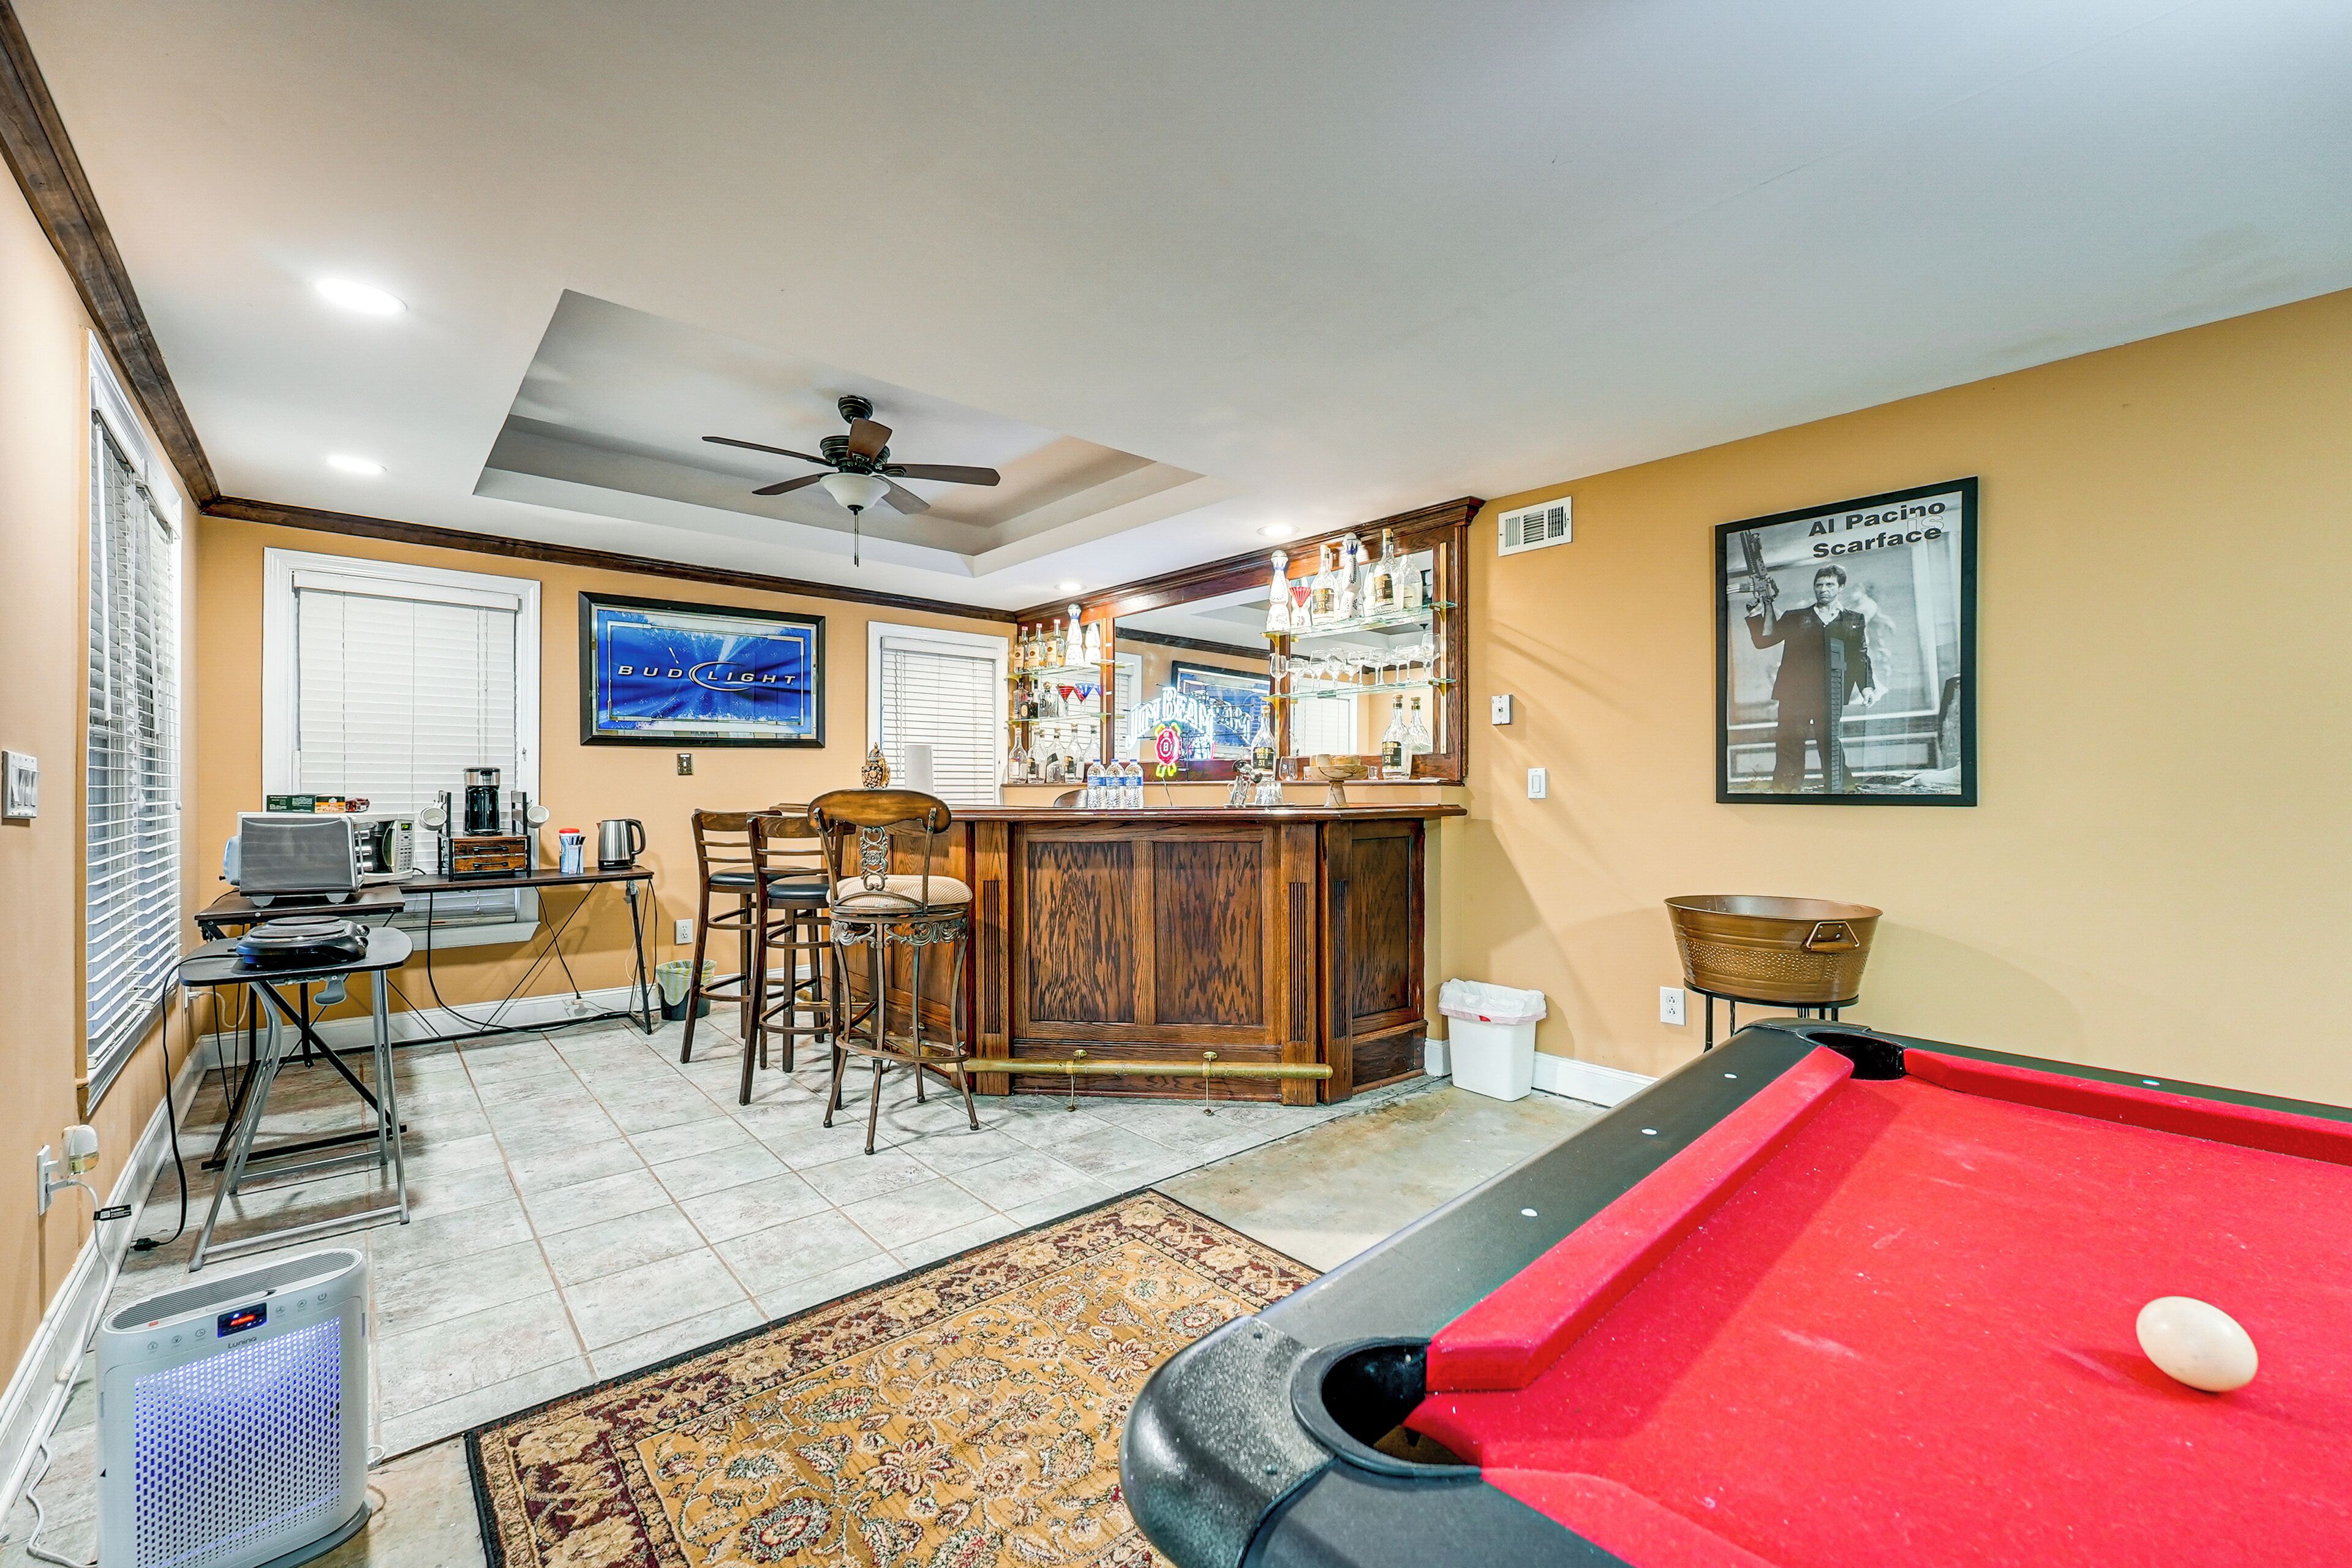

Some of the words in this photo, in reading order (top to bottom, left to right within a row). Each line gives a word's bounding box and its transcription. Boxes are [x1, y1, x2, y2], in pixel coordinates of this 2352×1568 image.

[1809, 518, 1834, 537] Al
[1845, 502, 1946, 530] Pacino
[1907, 513, 1945, 534] is
[1813, 527, 1942, 558] Scarface
[617, 665, 684, 679] BUD
[707, 670, 796, 685] LIGHT
[1125, 697, 1163, 750] JIM
[1162, 686, 1215, 741] BEAM
[228, 1336, 257, 1349] Lunino
